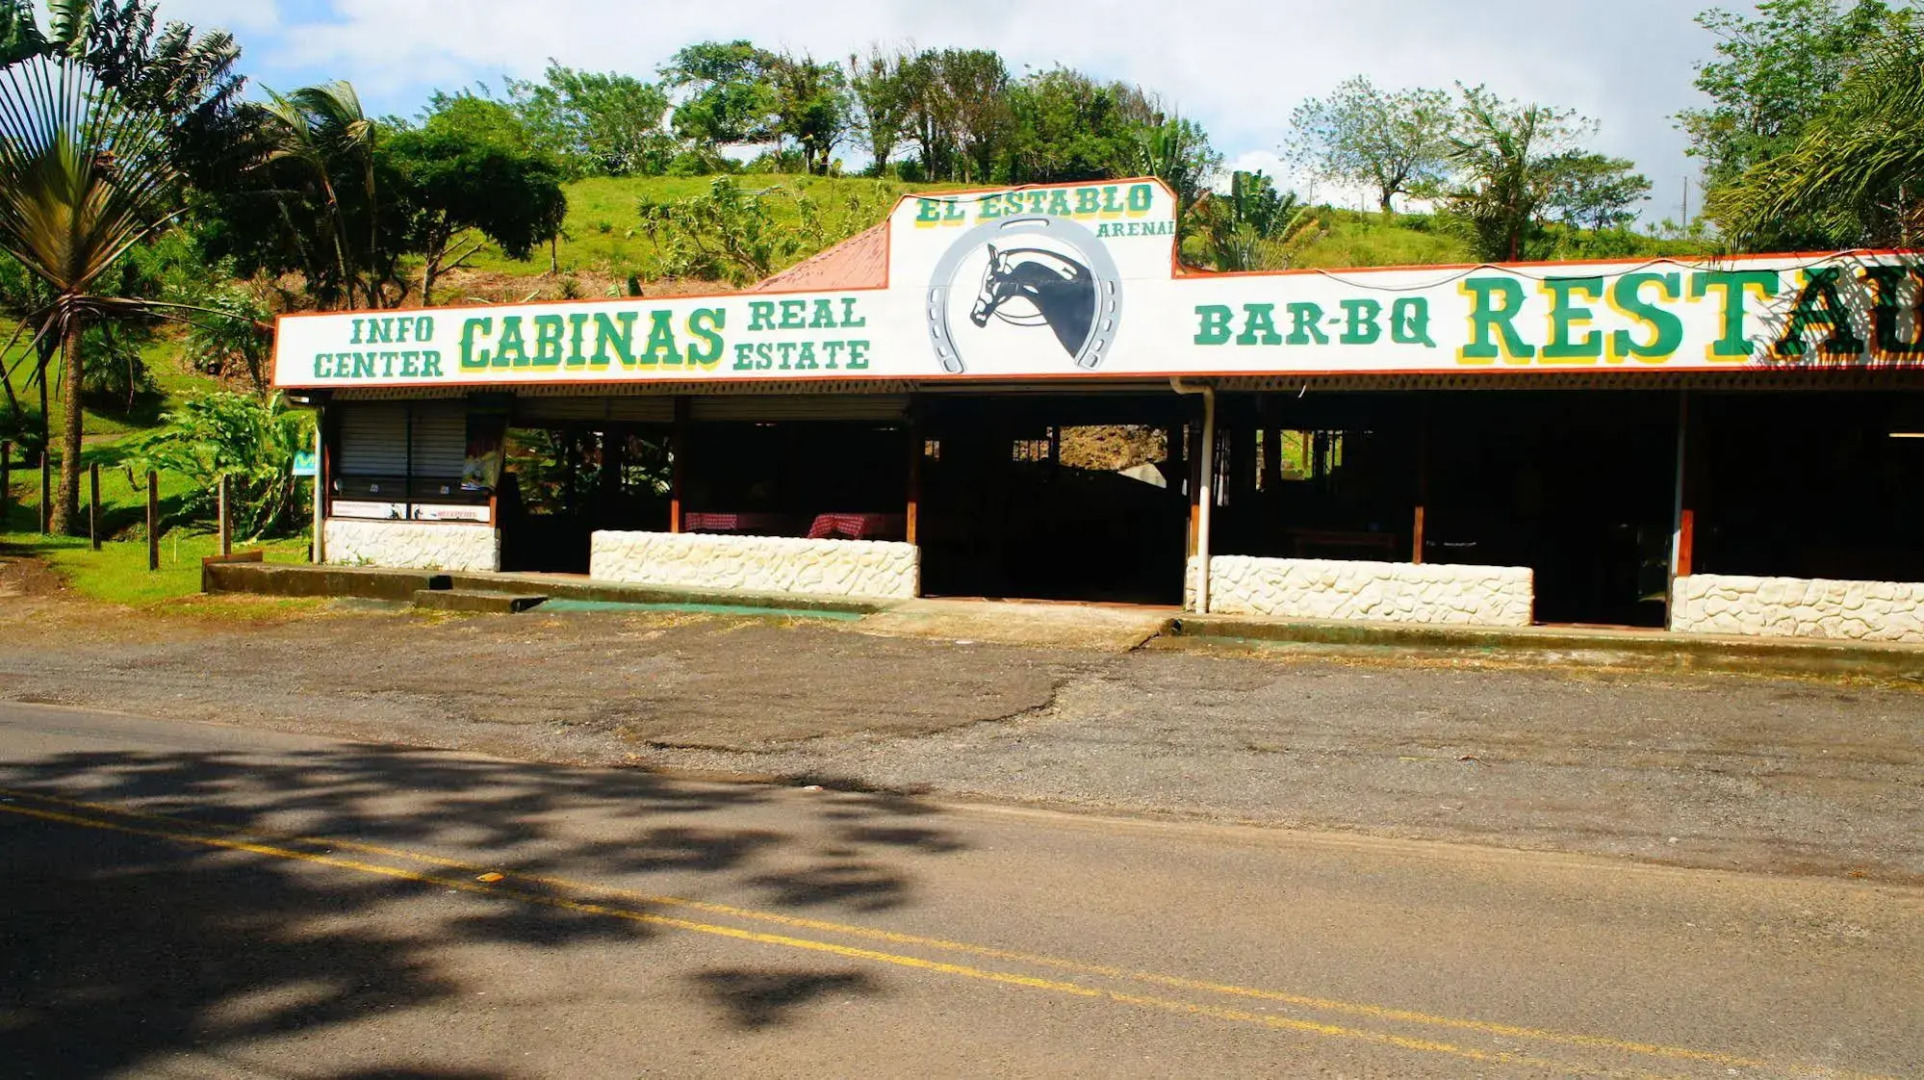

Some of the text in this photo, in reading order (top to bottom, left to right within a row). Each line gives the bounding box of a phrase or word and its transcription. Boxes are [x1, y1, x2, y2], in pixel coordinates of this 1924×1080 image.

[914, 184, 1154, 227] EL ESTABLO
[350, 316, 434, 344] INFO
[747, 297, 867, 331] REAL
[1193, 297, 1437, 348] BAR-BQ
[459, 307, 726, 374] CABINAS
[732, 339, 871, 371] ESTATE
[313, 350, 444, 378] CENTER
